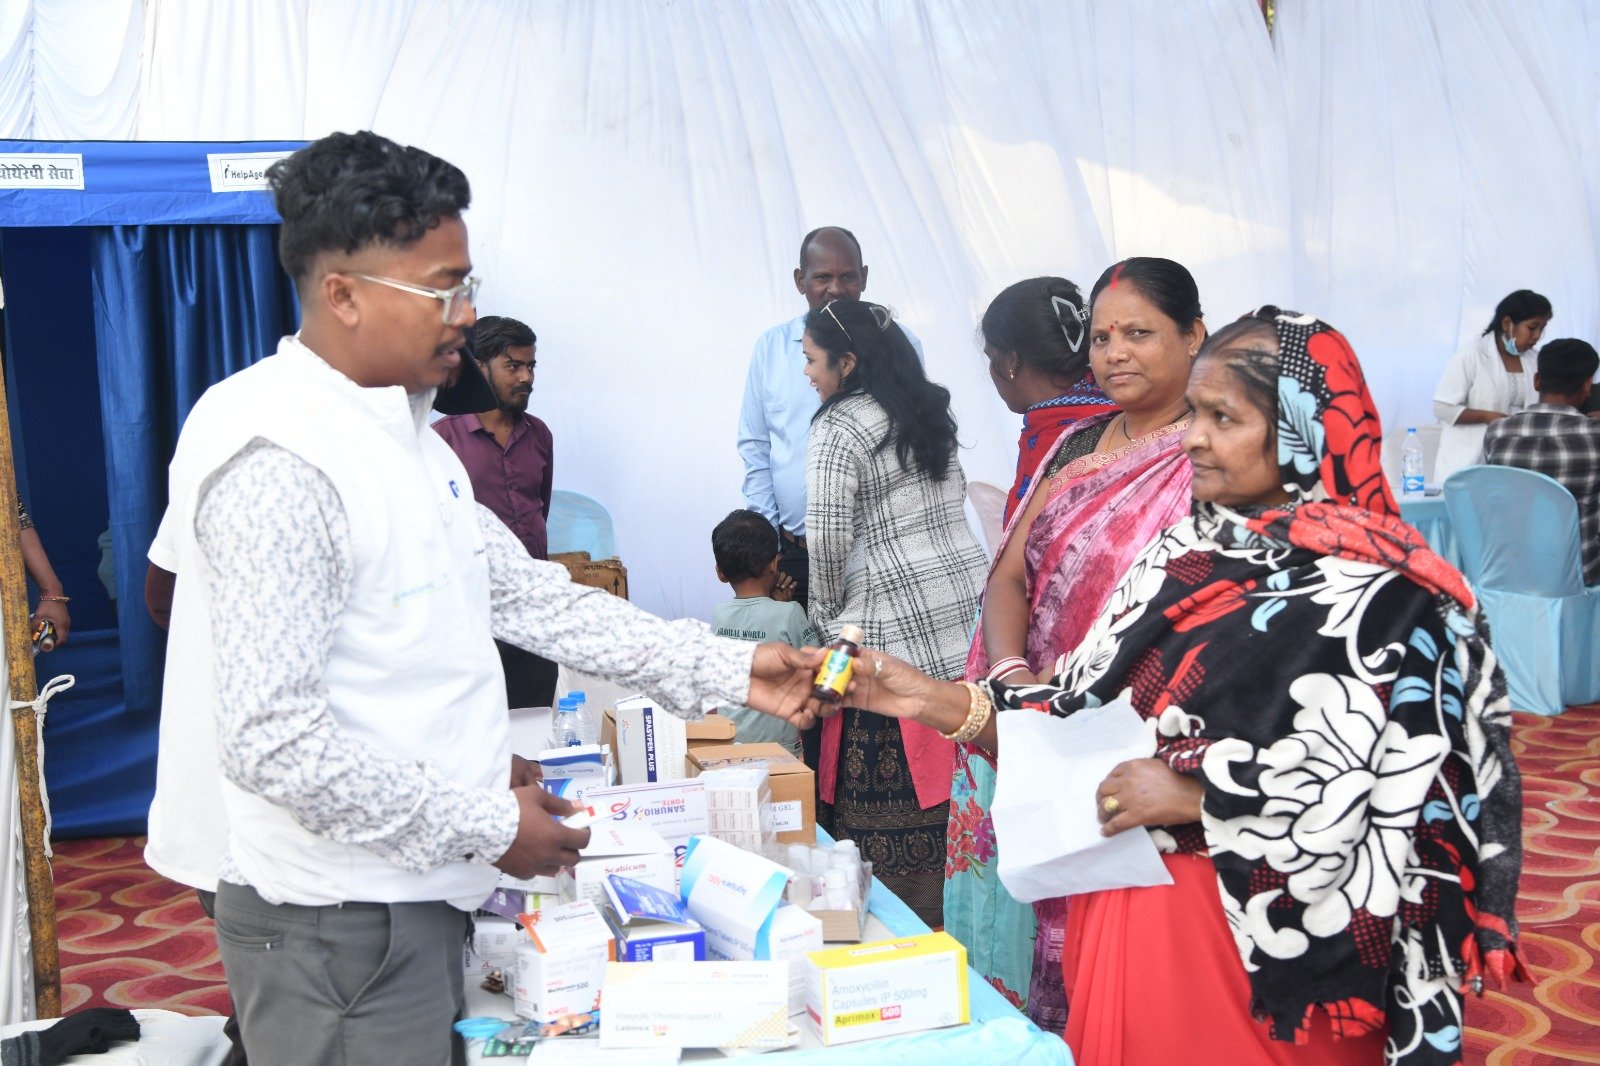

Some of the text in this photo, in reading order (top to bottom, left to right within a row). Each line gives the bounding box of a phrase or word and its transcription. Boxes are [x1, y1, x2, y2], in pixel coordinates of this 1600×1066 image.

[47, 164, 74, 180] सेवा
[231, 170, 263, 180] HelpAge
[717, 627, 766, 639] GLOBAL WORLD
[645, 715, 654, 752] SPASYPEN
[778, 804, 794, 812] GEL
[832, 978, 889, 995] Amoxycillin
[832, 987, 928, 1011] Capsules IP 500mg
